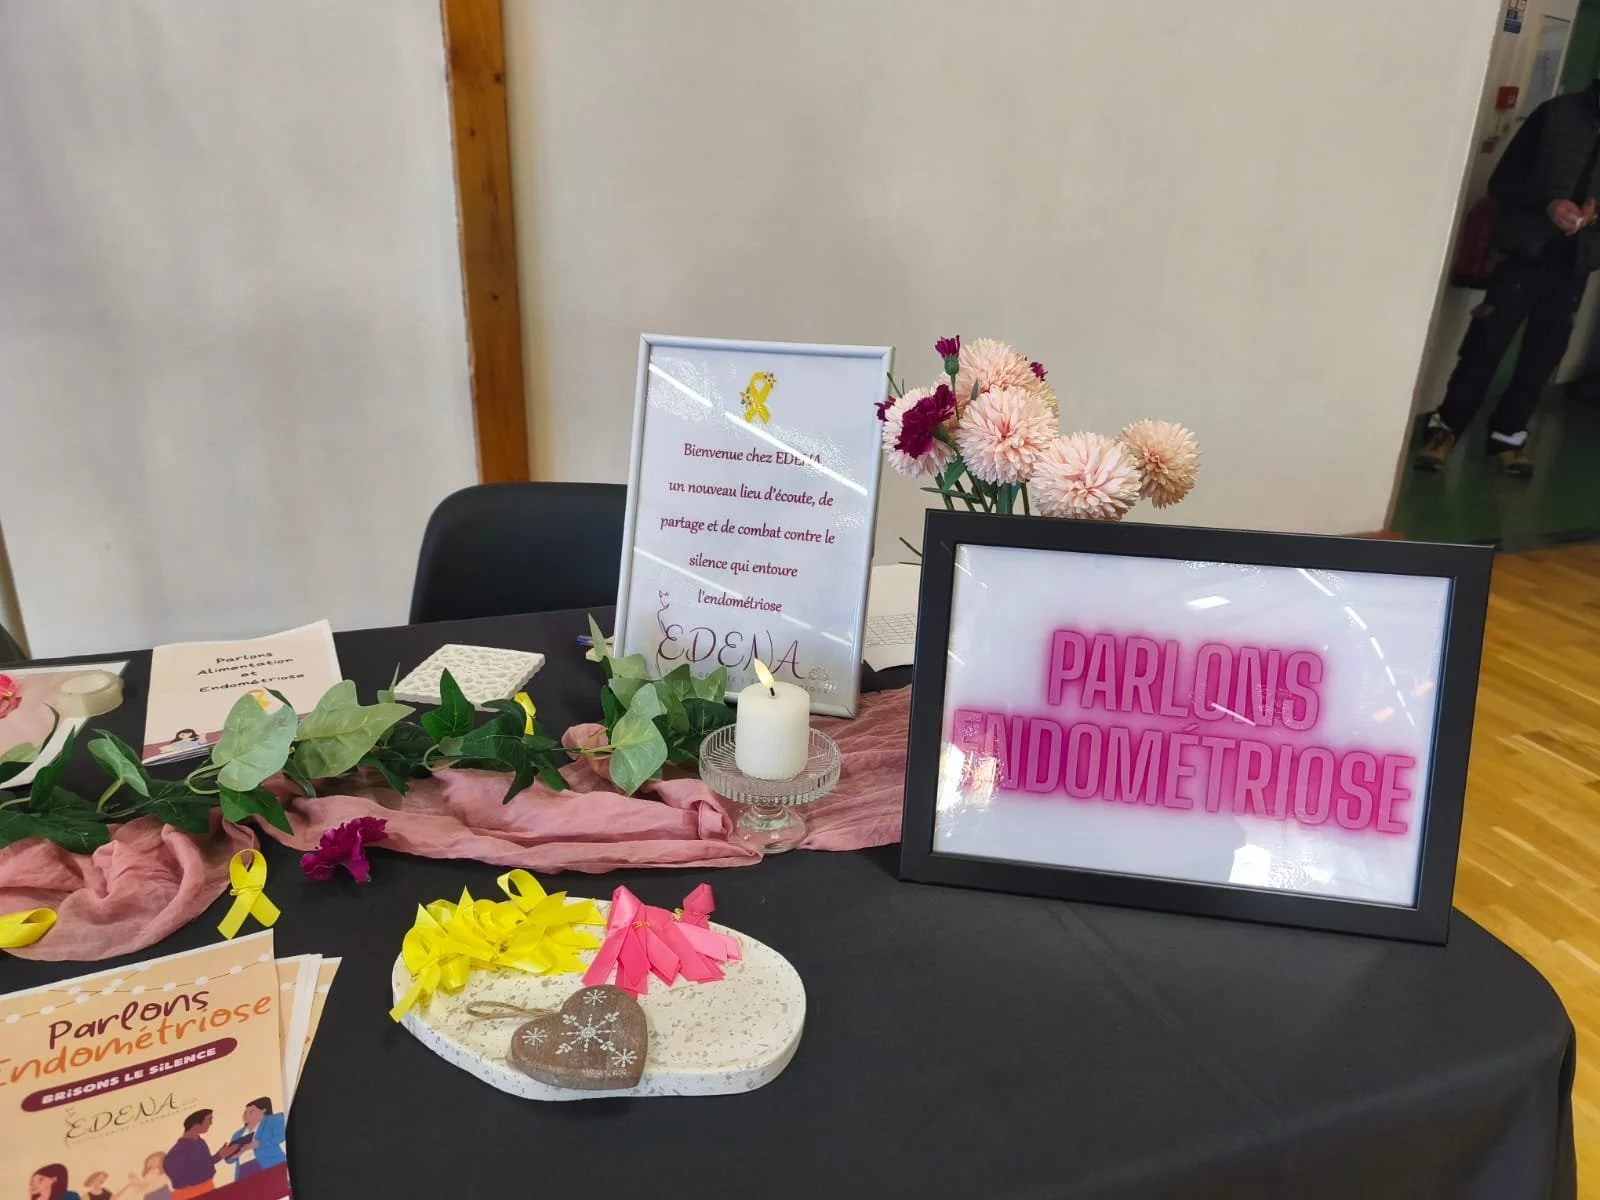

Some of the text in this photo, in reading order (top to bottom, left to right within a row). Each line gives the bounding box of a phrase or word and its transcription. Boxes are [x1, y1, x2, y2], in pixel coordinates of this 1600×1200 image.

[684, 443, 744, 461] Bienvenue
[746, 448, 773, 464] chez
[668, 482, 685, 492] un
[688, 484, 737, 498] nouveau
[740, 484, 762, 500] lieu
[818, 491, 834, 507] de
[660, 517, 836, 544] partage et de combat contre le
[689, 553, 798, 577] silence qui entoure
[698, 588, 783, 613] l'endométriose
[215, 652, 273, 664] Parlons
[657, 623, 806, 680] EDENA
[196, 658, 294, 676] Alimentation
[240, 670, 258, 678] et
[199, 673, 305, 693] Endométriose
[1047, 629, 1323, 732] PARLONS
[48, 990, 210, 1050] Parlons
[124, 1069, 145, 1083] LE
[66, 1092, 180, 1139] EDENA
